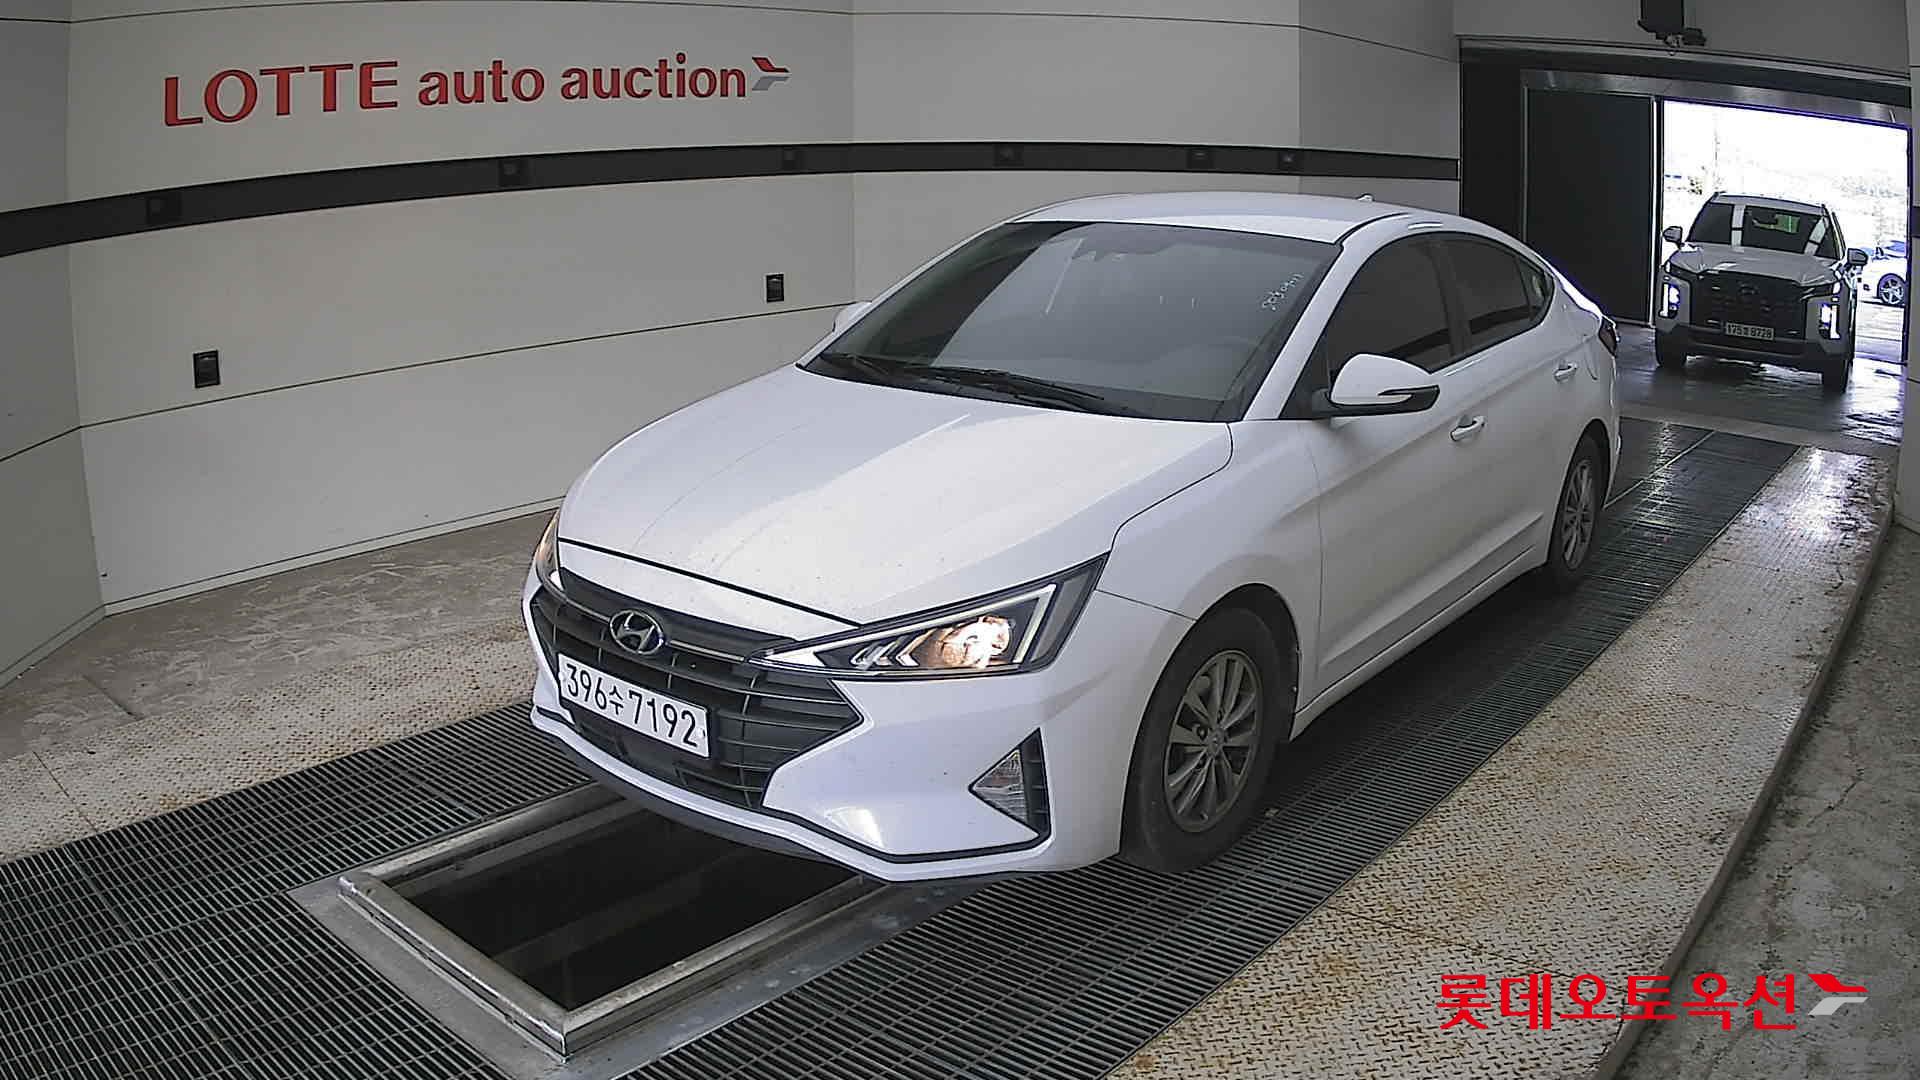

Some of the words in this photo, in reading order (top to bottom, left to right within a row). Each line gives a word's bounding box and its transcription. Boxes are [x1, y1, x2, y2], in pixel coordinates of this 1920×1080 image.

[164, 61, 398, 126] LOTTE
[418, 59, 544, 106] auto
[561, 53, 747, 99] auction
[566, 663, 698, 748] 396수7192
